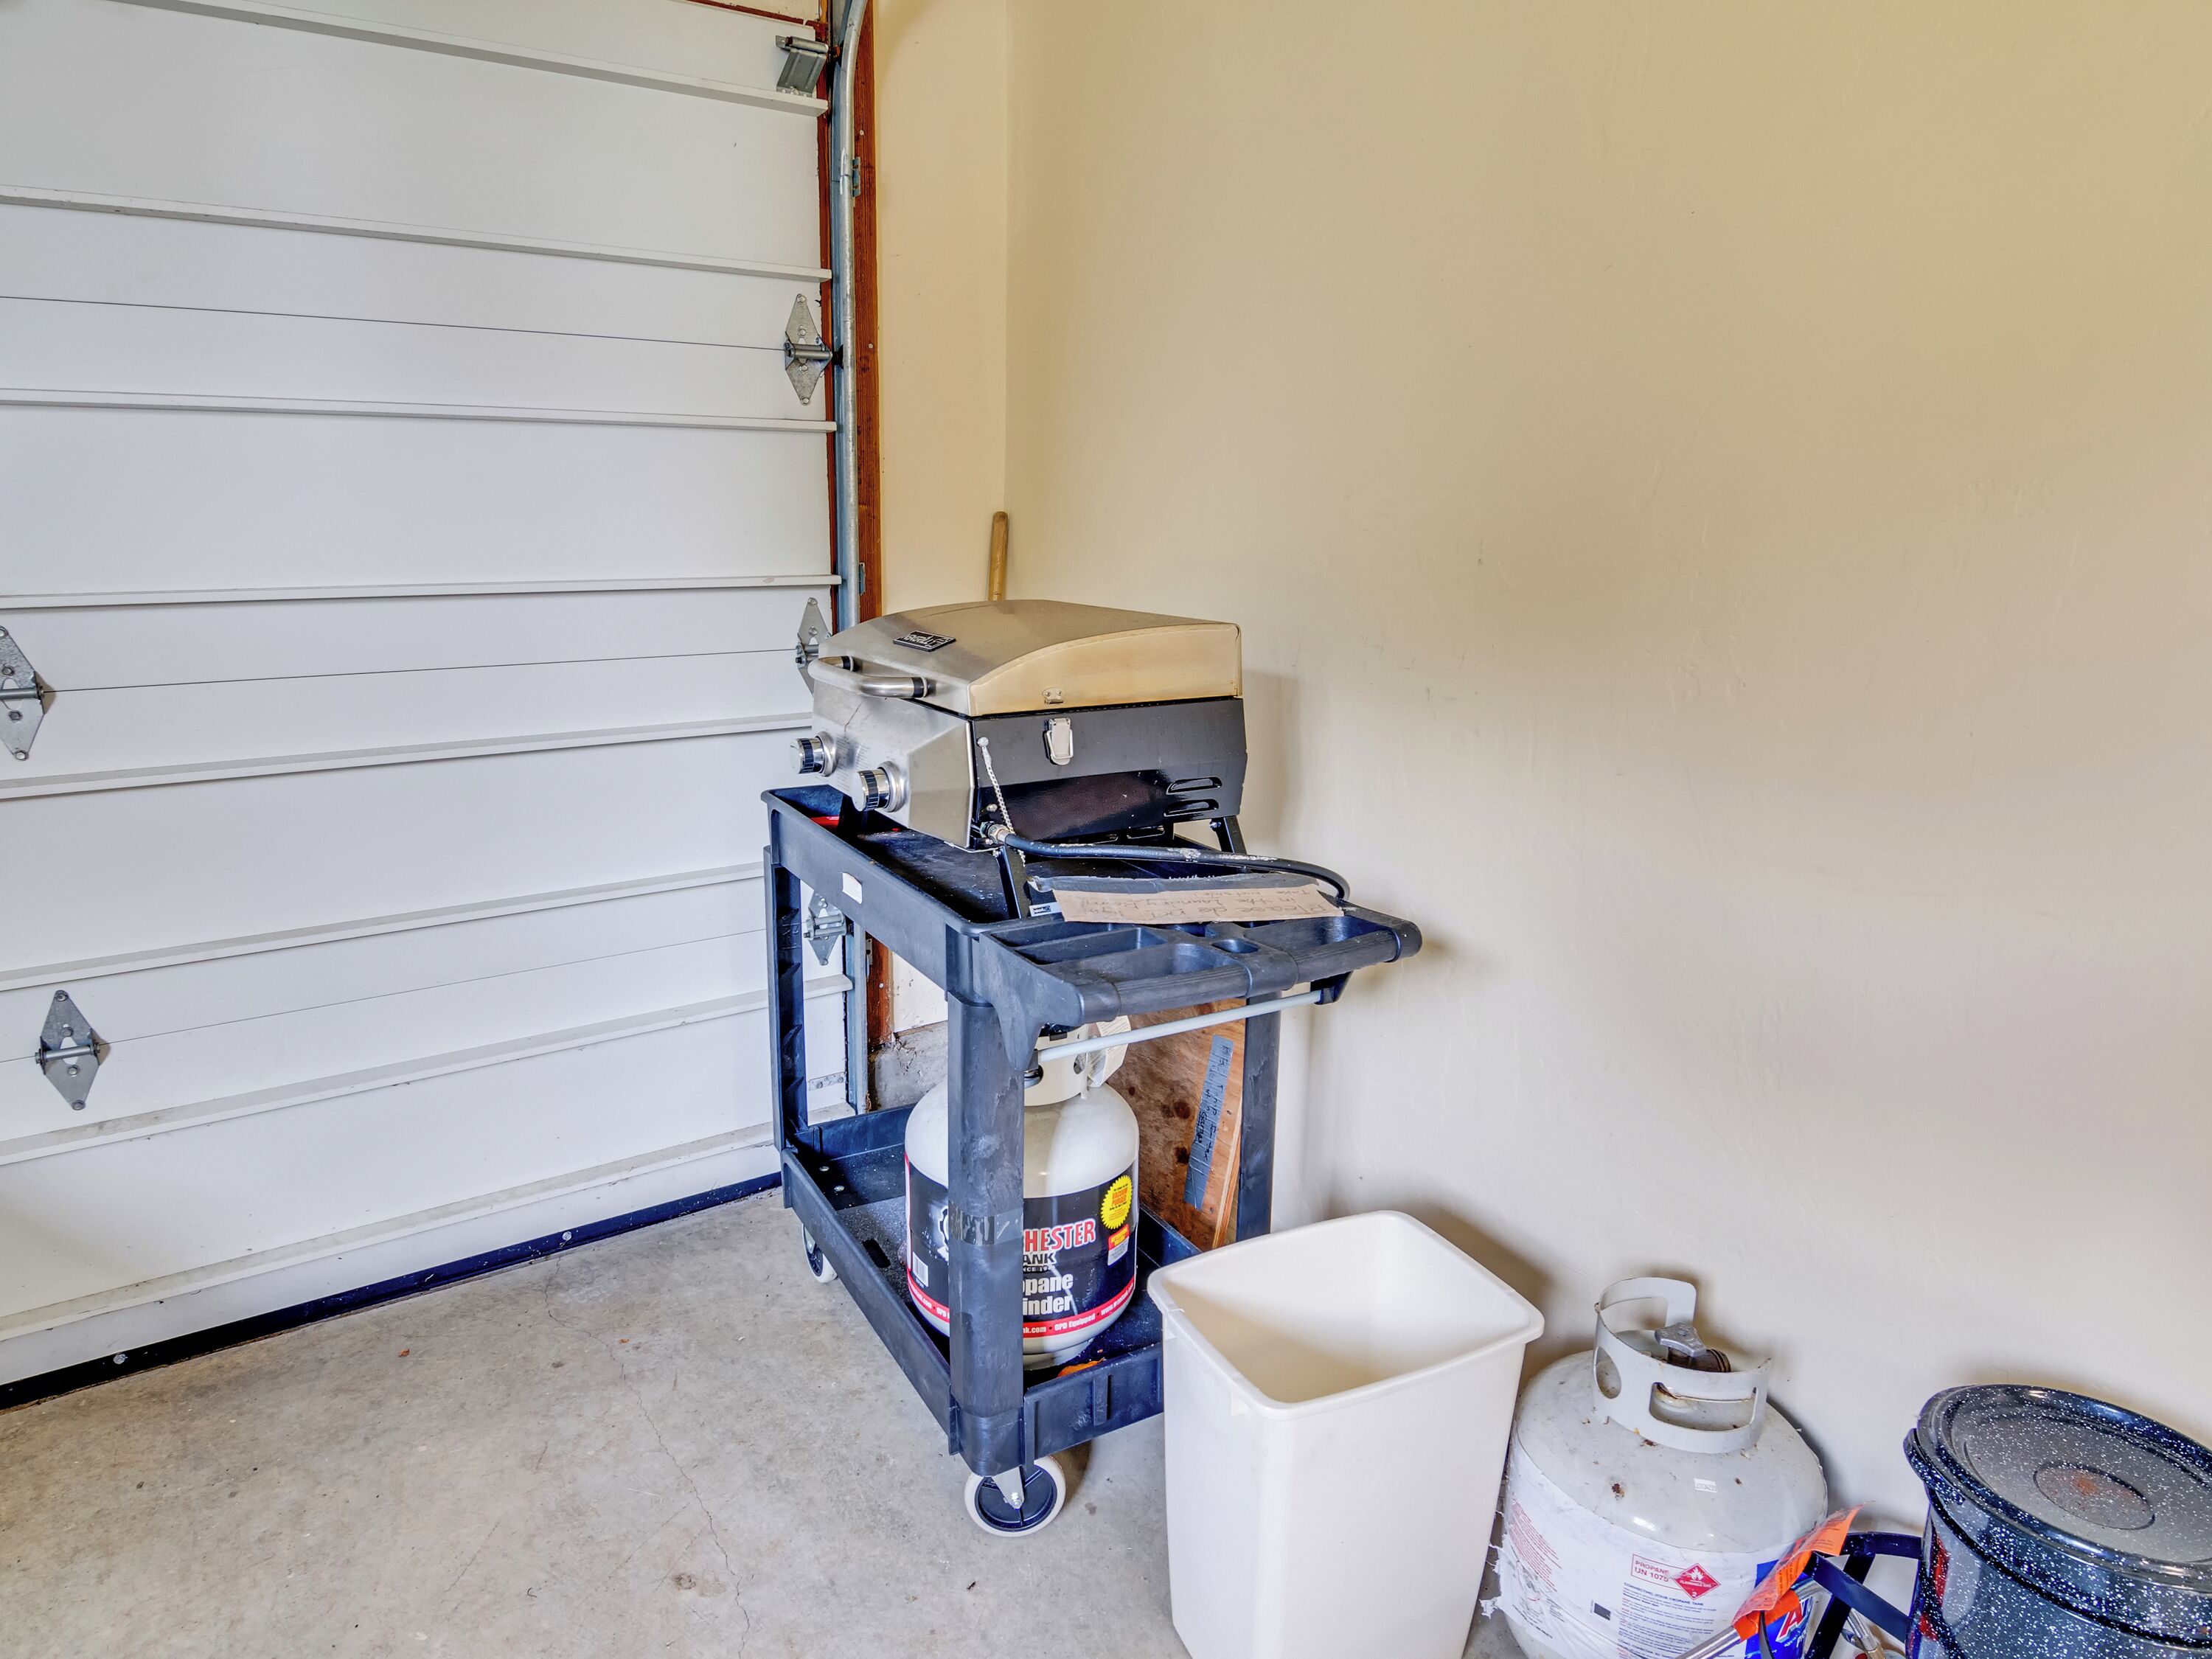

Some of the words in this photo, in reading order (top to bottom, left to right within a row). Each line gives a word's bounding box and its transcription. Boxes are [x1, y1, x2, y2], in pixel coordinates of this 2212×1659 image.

[1023, 1220, 1096, 1252] HESTER
[1023, 1252, 1056, 1265] ANK
[1023, 1273, 1074, 1296] pane
[1023, 1294, 1073, 1315] inder
[1023, 1326, 1047, 1334] nk.com
[1635, 1560, 1669, 1575] PROPANE
[1635, 1567, 1647, 1576] UN
[1650, 1572, 1669, 1582] 1075
